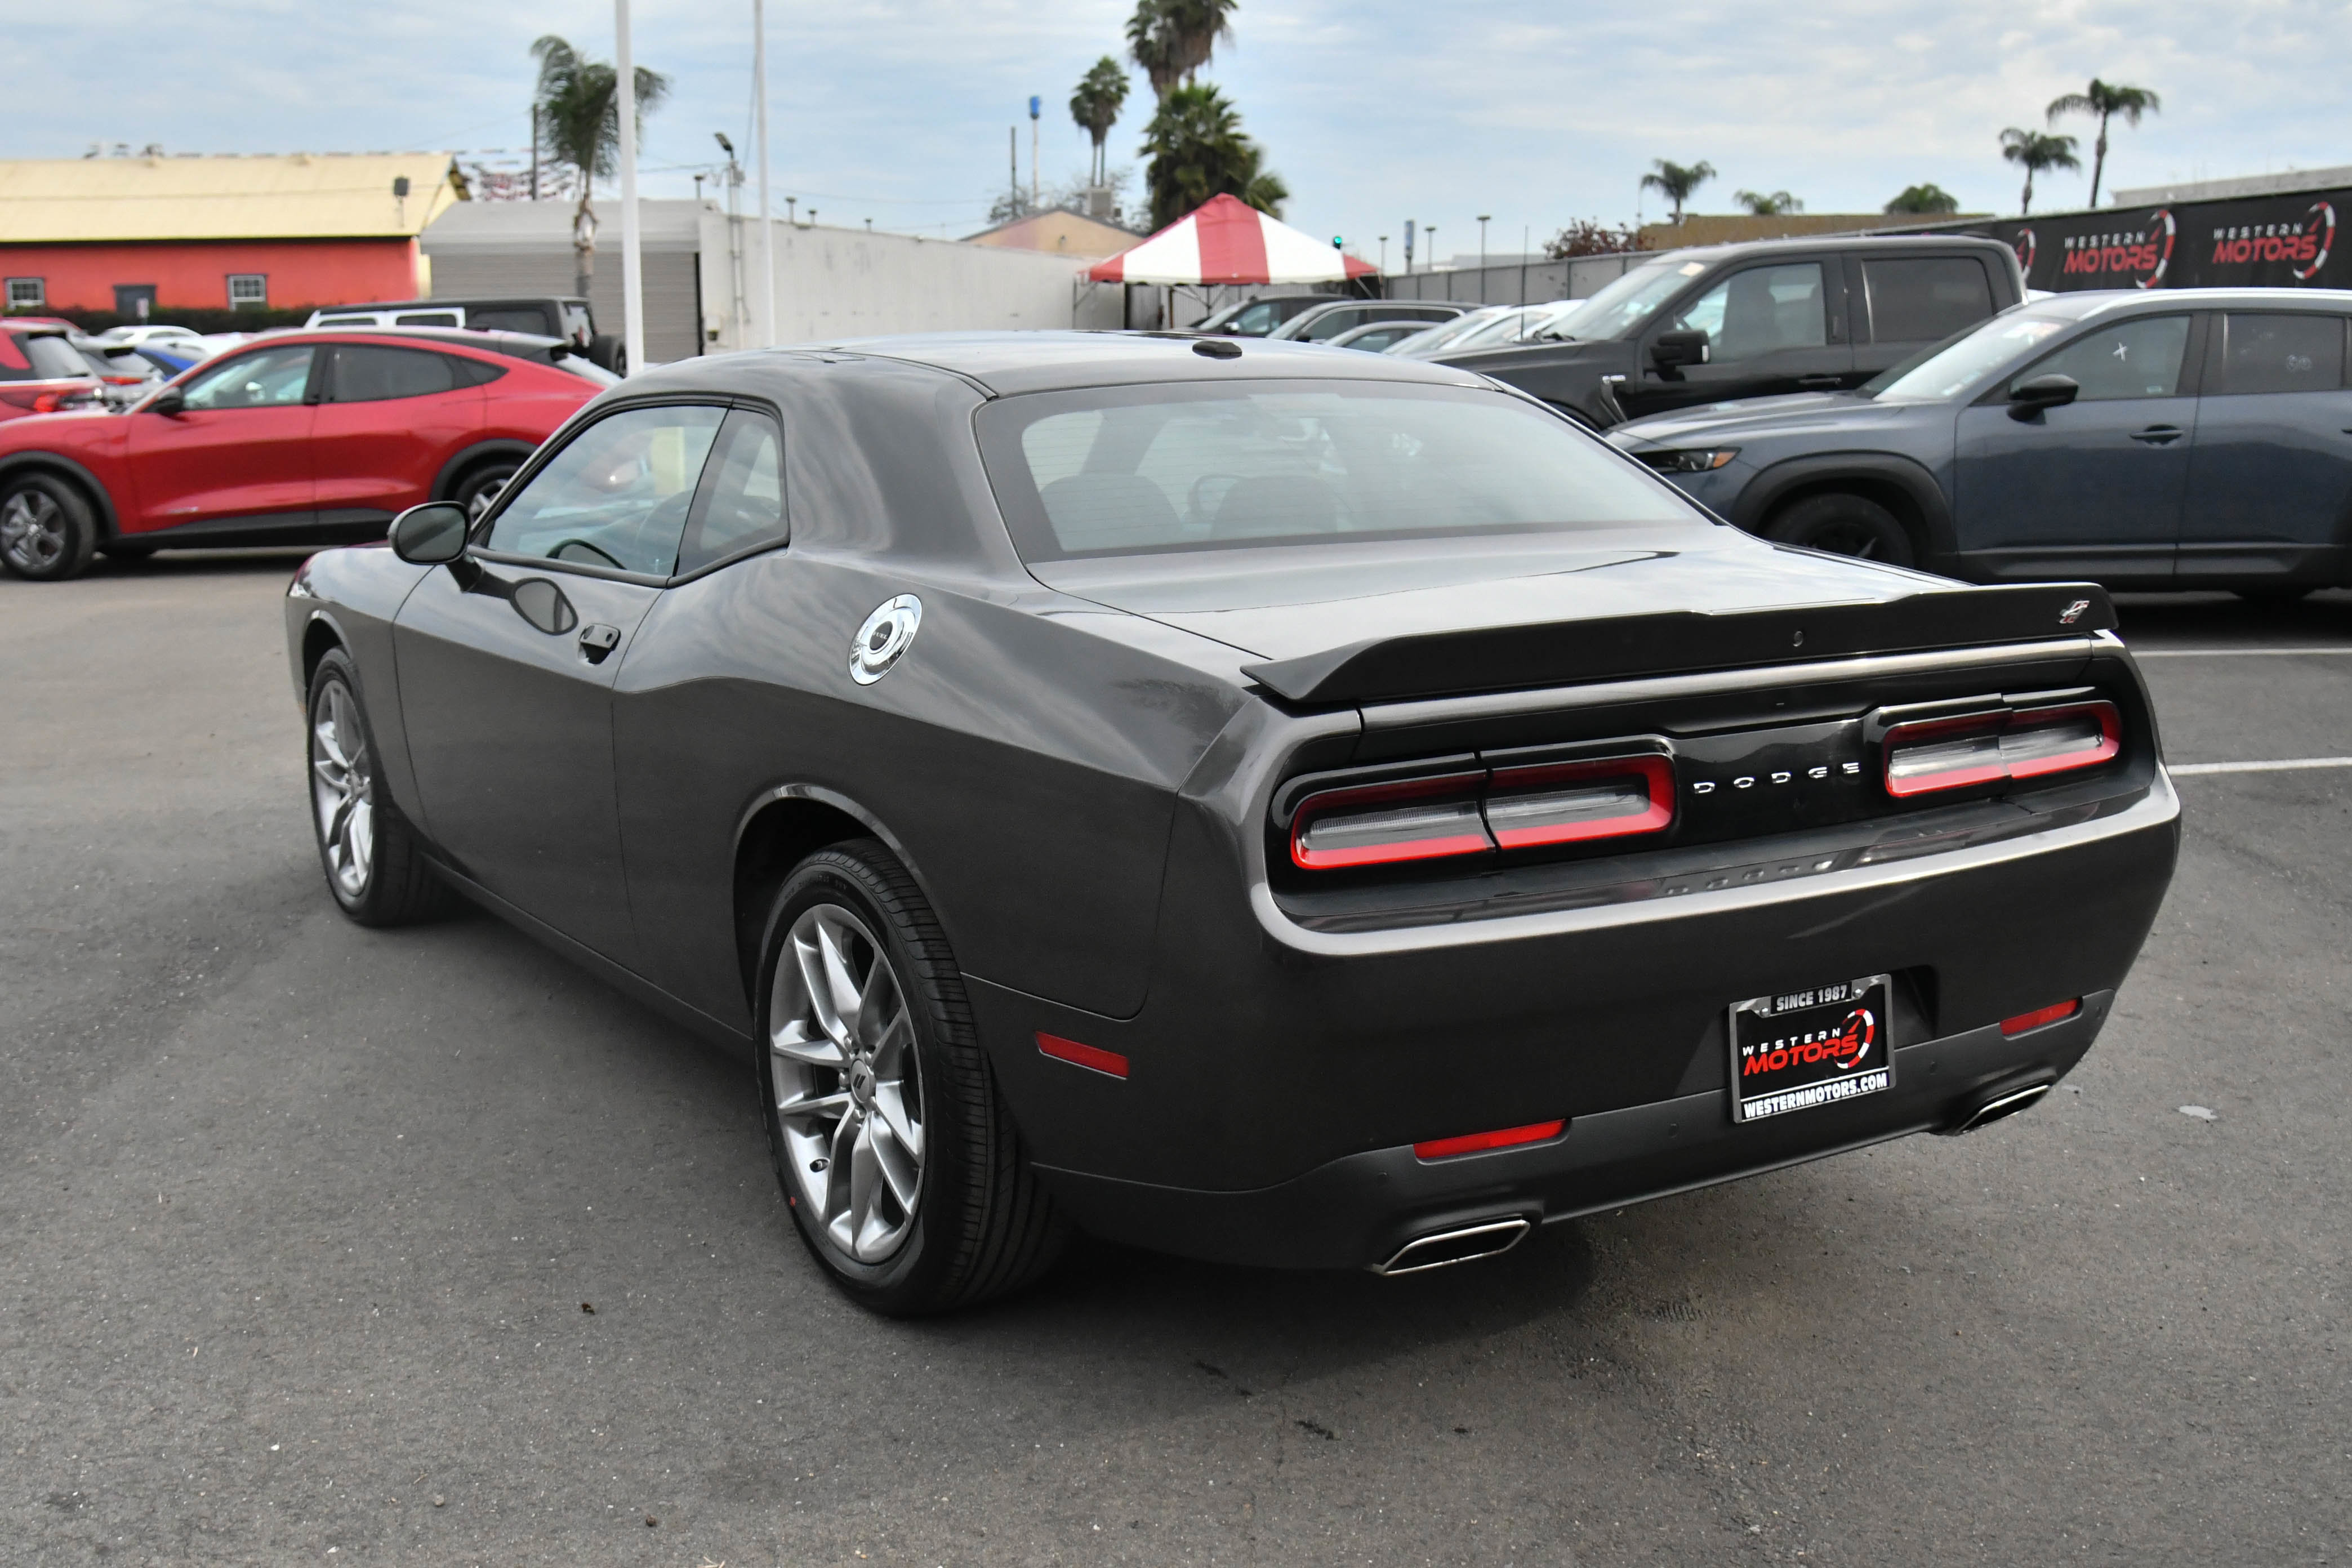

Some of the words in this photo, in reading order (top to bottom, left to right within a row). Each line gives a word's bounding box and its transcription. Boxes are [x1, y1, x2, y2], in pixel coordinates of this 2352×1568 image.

[2065, 230, 2145, 249] WESTERN
[2213, 222, 2302, 240] WESTERN
[2064, 243, 2158, 274] MOTORS
[2212, 234, 2318, 265] MOTORS
[873, 631, 888, 640] FUEL
[1694, 762, 1860, 794] DODGE
[1776, 991, 1814, 1012] SINCE
[1818, 985, 1847, 1003] 1987
[1743, 1027, 1841, 1057] WESTERN
[1744, 1033, 1858, 1076] MOTORS
[1744, 1072, 1887, 1119] WESTERNMOTORS.COM
